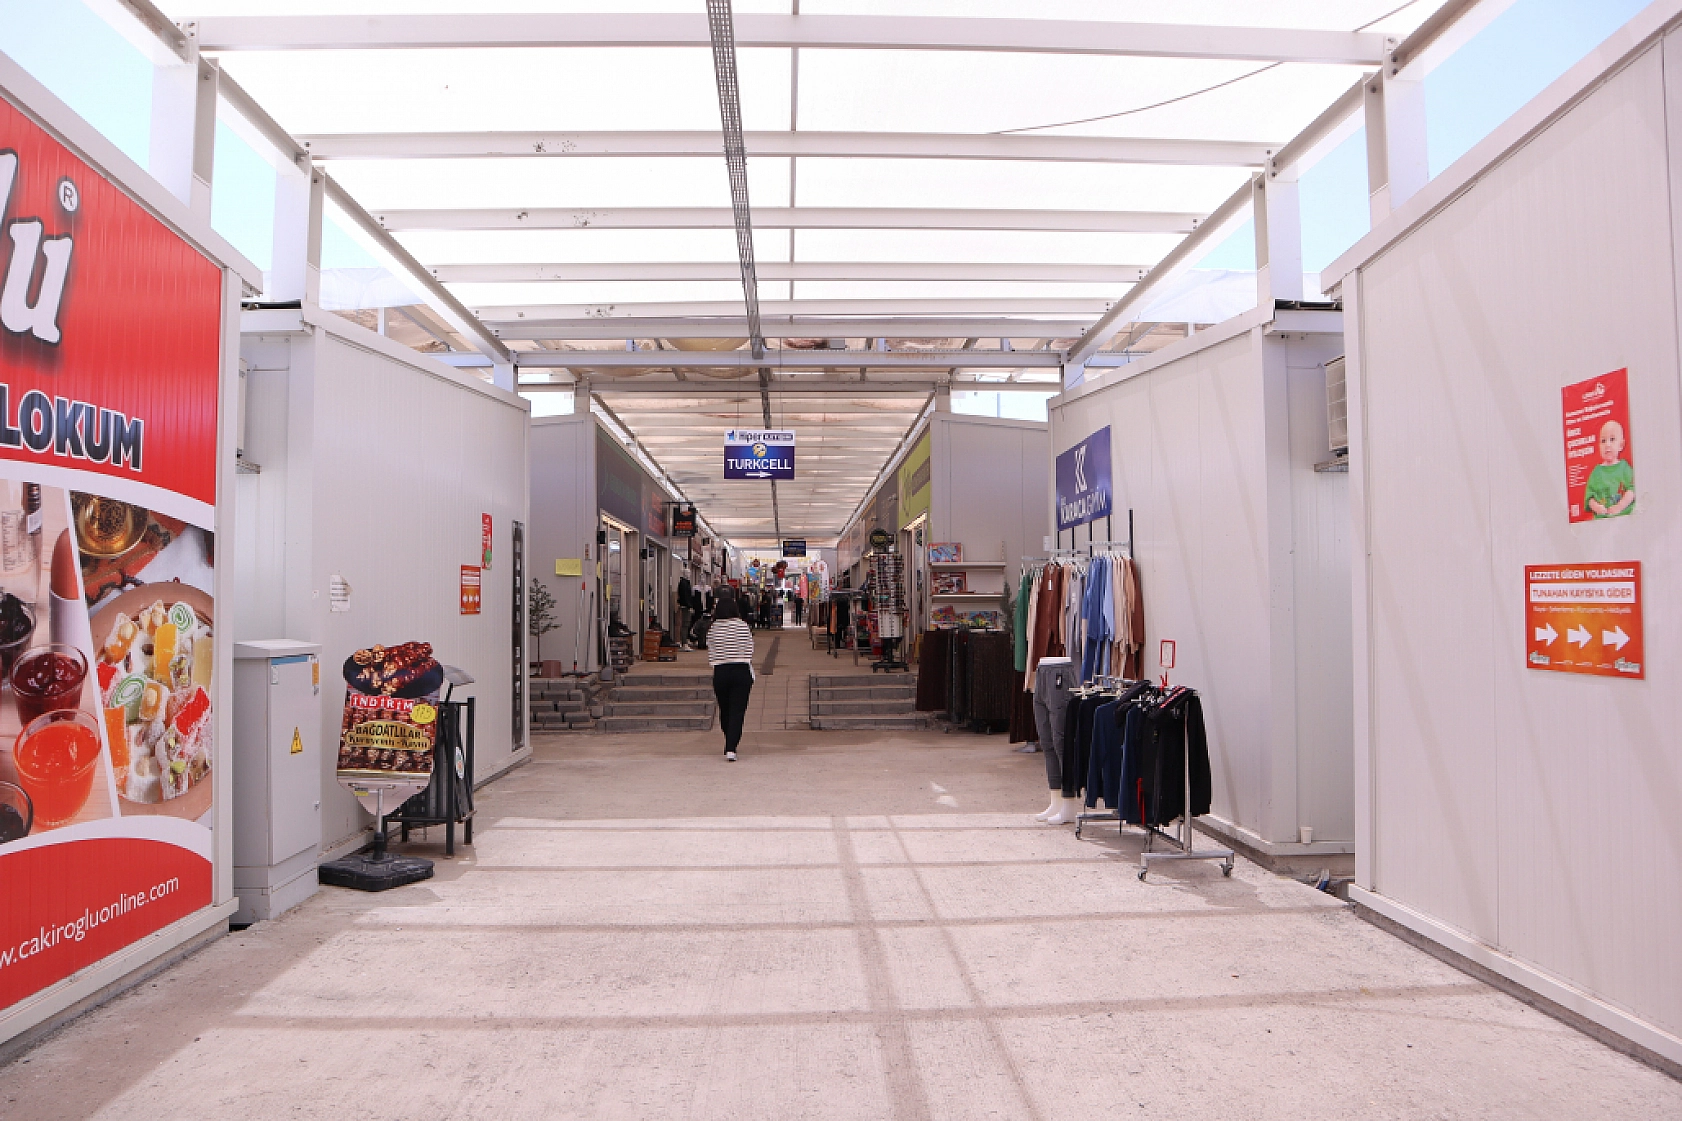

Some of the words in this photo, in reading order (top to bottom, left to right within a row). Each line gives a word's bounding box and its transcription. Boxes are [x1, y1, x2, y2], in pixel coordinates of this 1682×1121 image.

[0, 383, 144, 472] LOKUM
[727, 459, 792, 470] TURKCELL
[1607, 587, 1632, 597] GİDER
